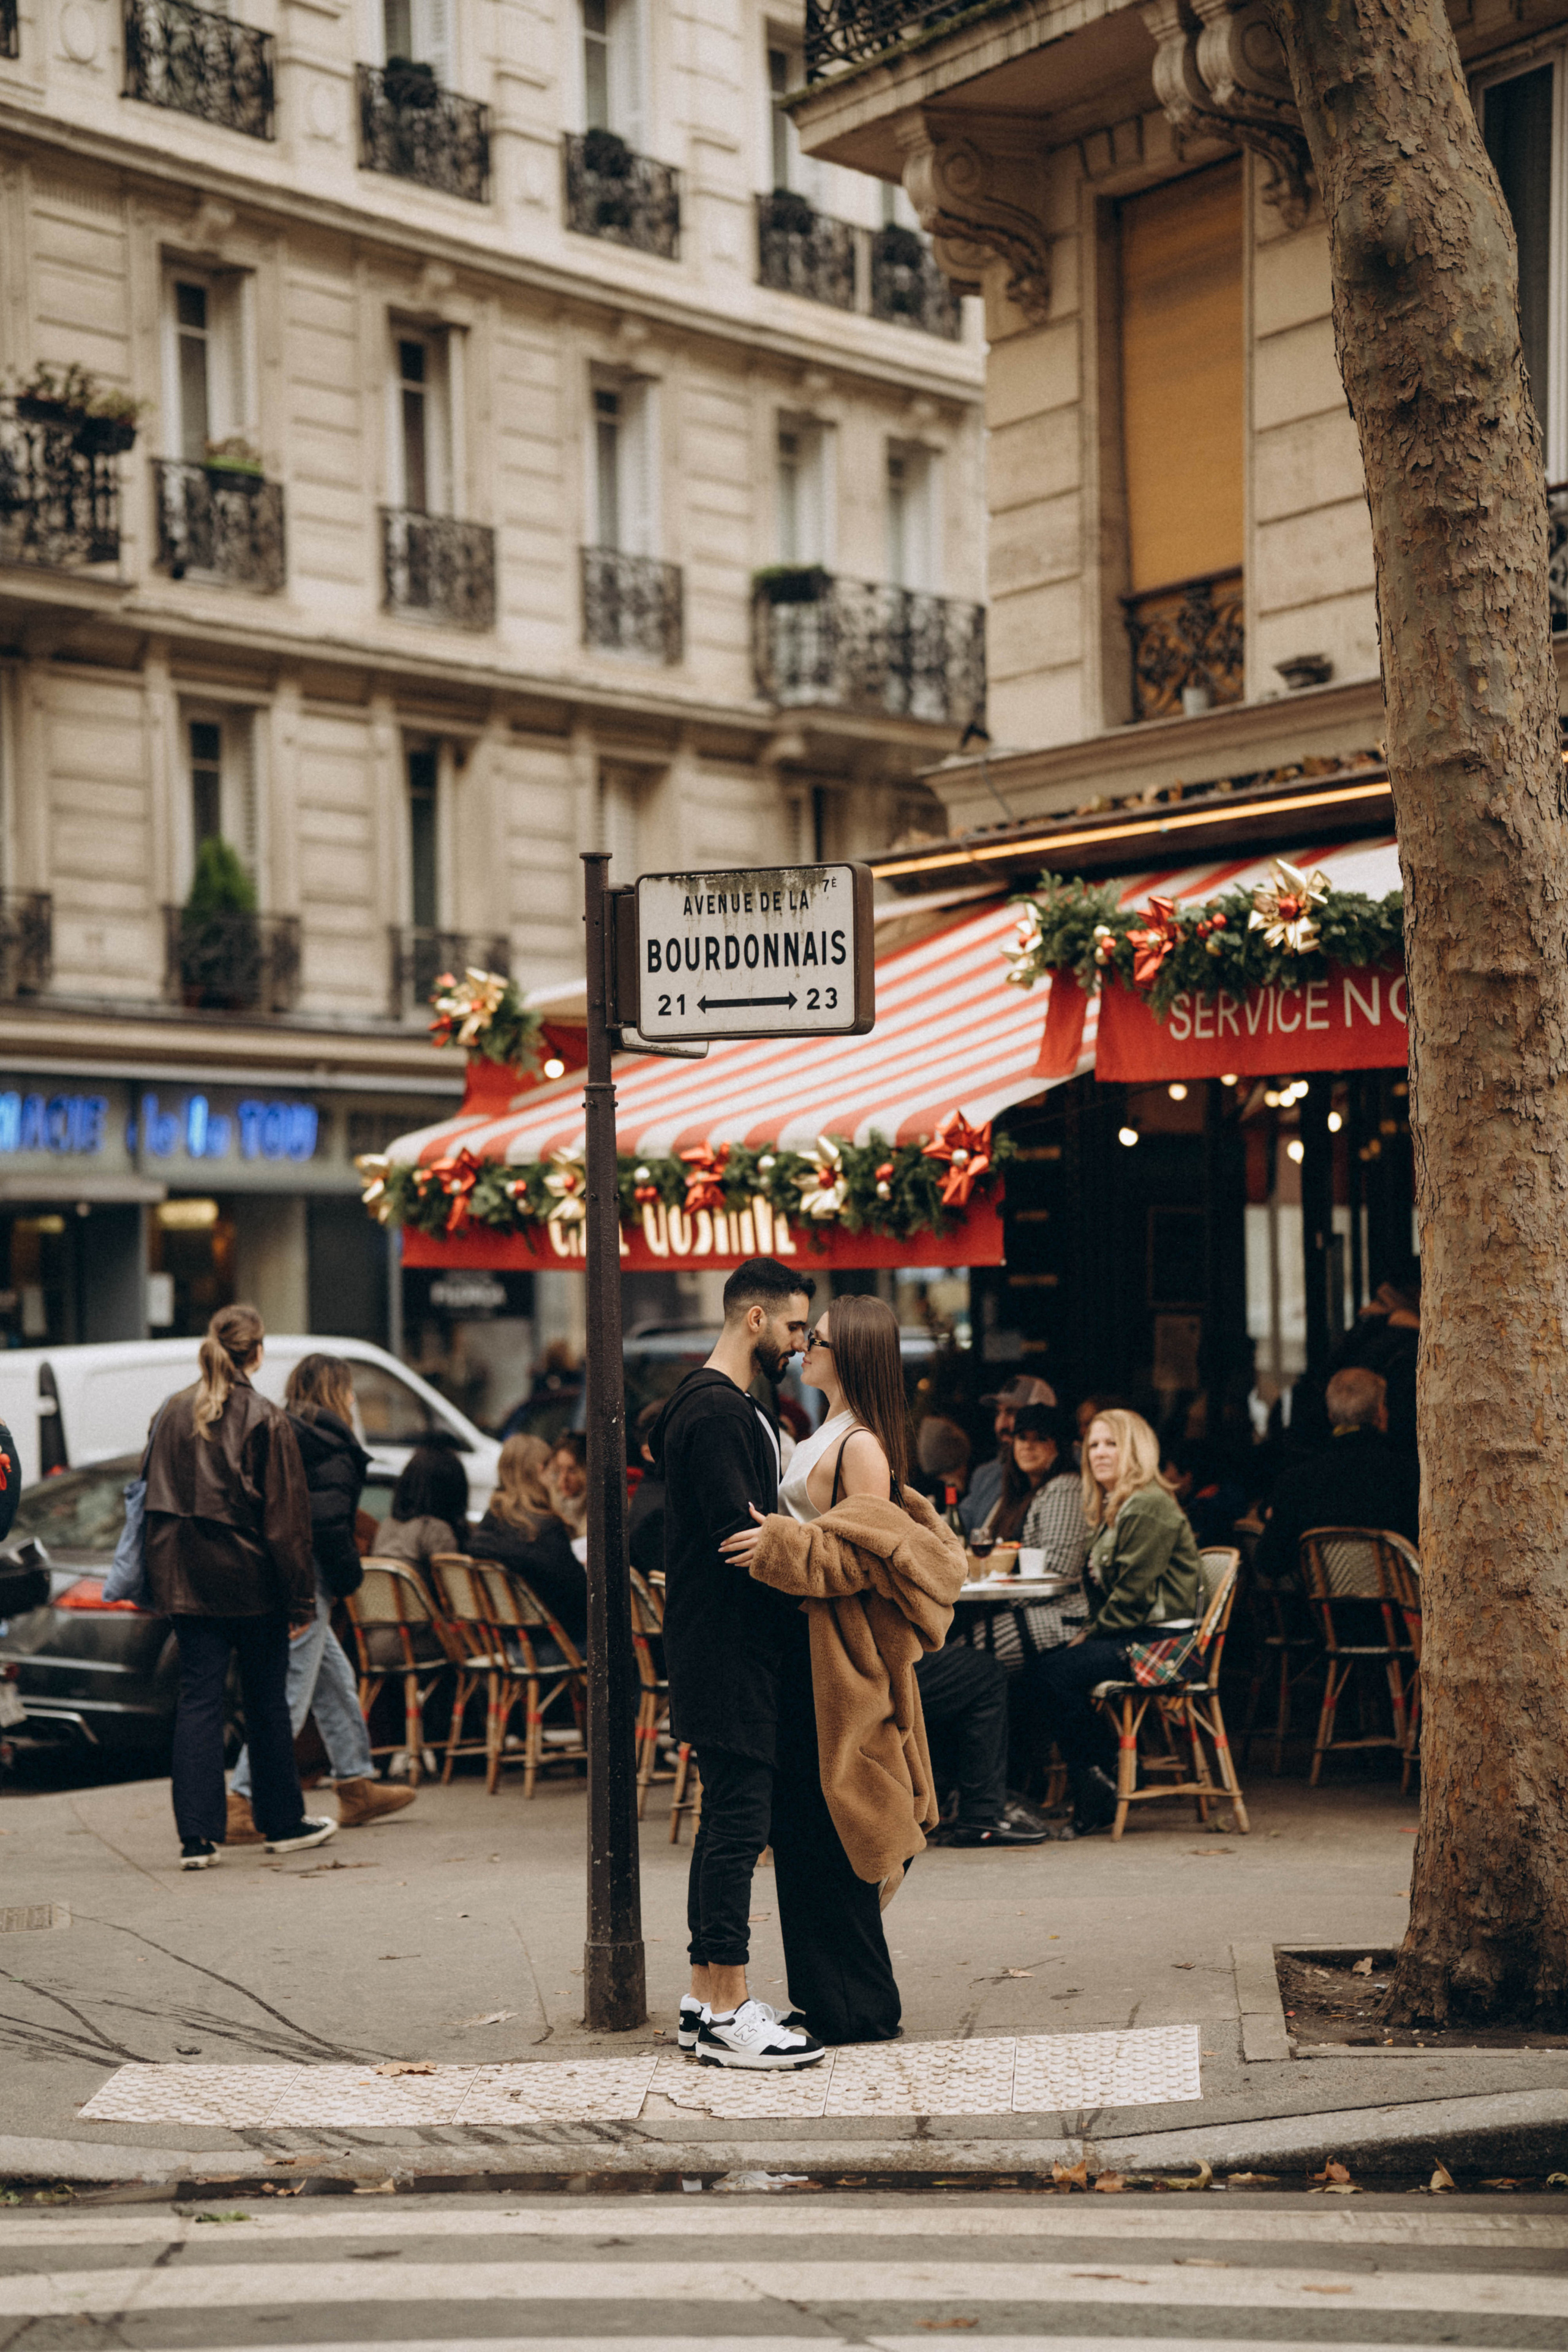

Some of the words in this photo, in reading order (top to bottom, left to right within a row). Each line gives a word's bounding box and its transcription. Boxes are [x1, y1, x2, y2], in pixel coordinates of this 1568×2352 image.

[683, 892, 753, 915] AVENUE
[760, 891, 782, 912] DE
[789, 889, 809, 910] LA
[647, 930, 846, 973] BOURDONNAIS
[658, 993, 685, 1016] 21
[807, 987, 838, 1010] 23
[1169, 982, 1330, 1041] SERVICE
